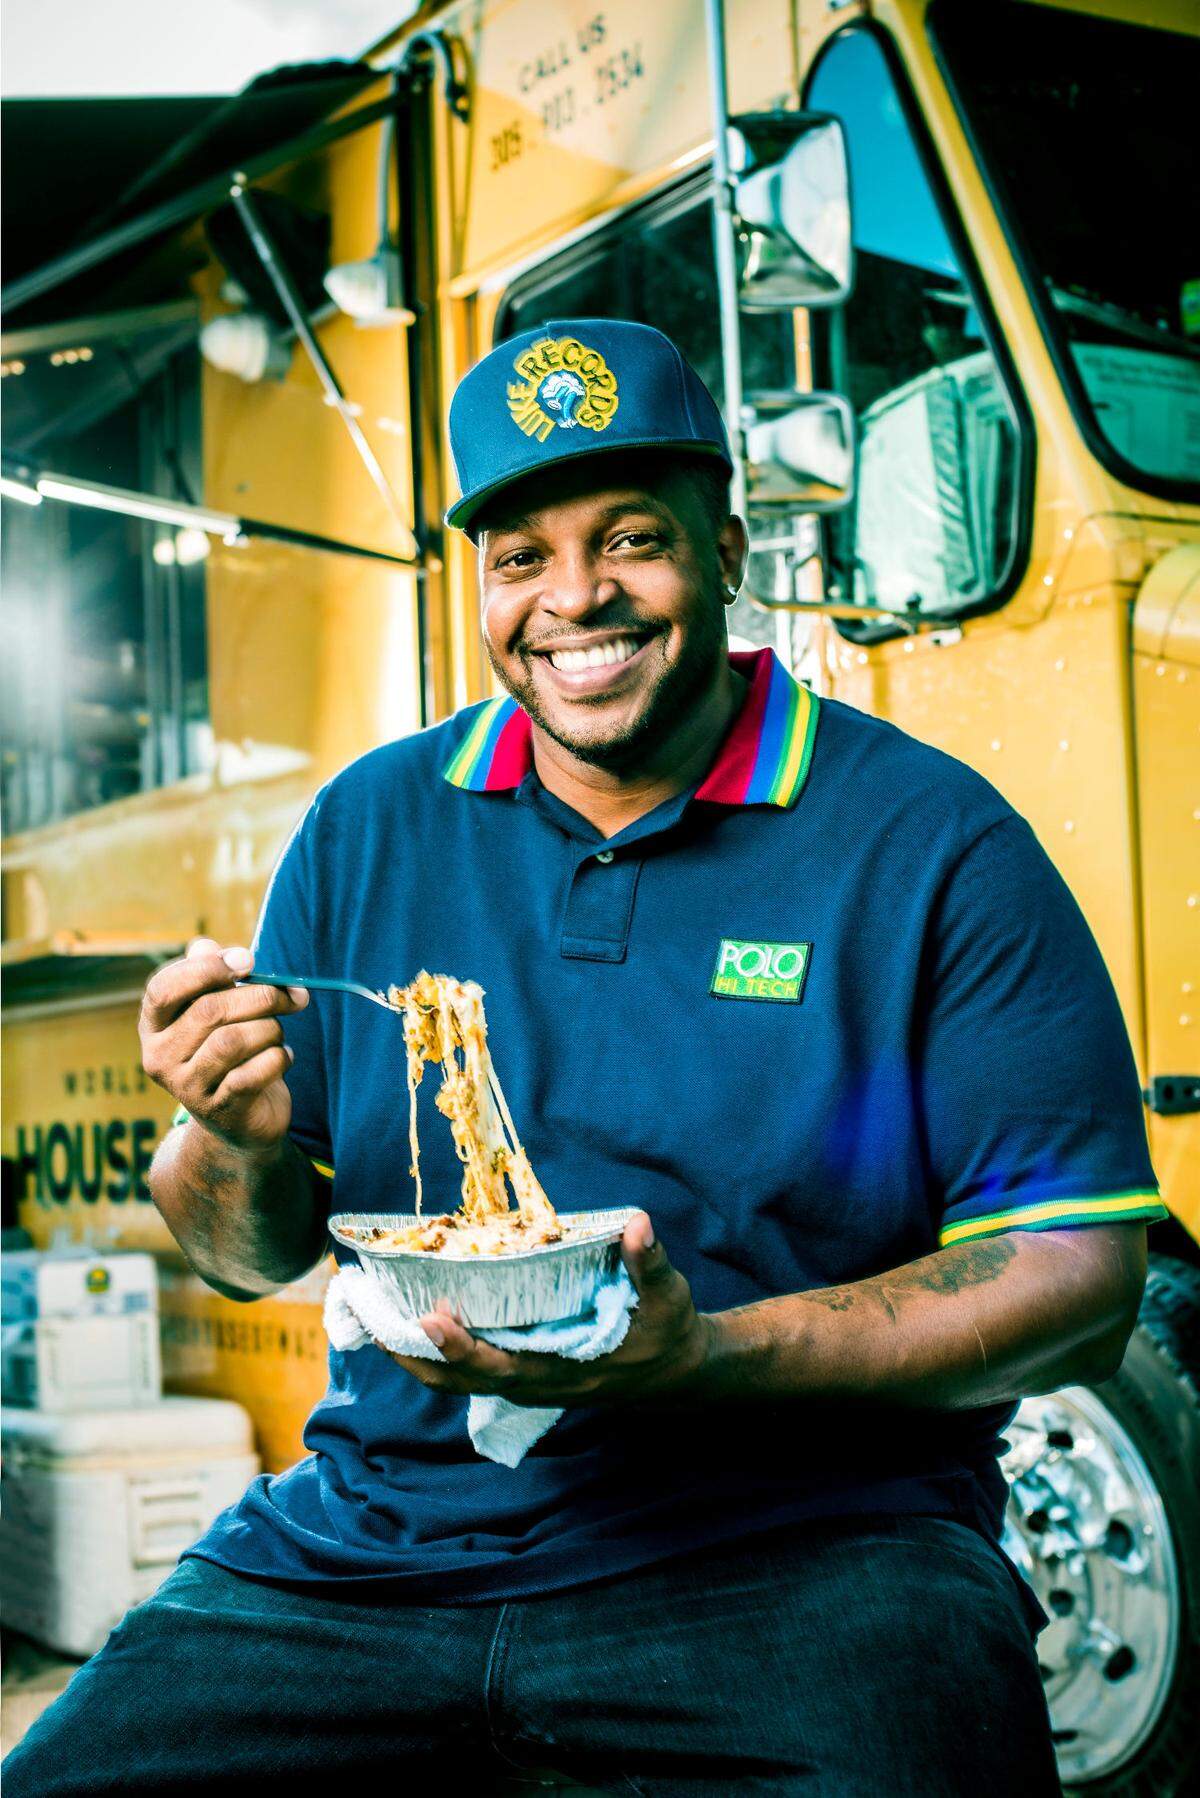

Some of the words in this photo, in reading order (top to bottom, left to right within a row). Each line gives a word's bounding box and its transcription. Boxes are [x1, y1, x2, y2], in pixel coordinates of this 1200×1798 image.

[507, 379, 556, 443] LUKE
[513, 337, 619, 432] RECORDS
[716, 978, 738, 993] HI
[745, 978, 799, 997] TECH
[718, 940, 804, 980] POLO
[17, 1118, 156, 1204] HOUSE
